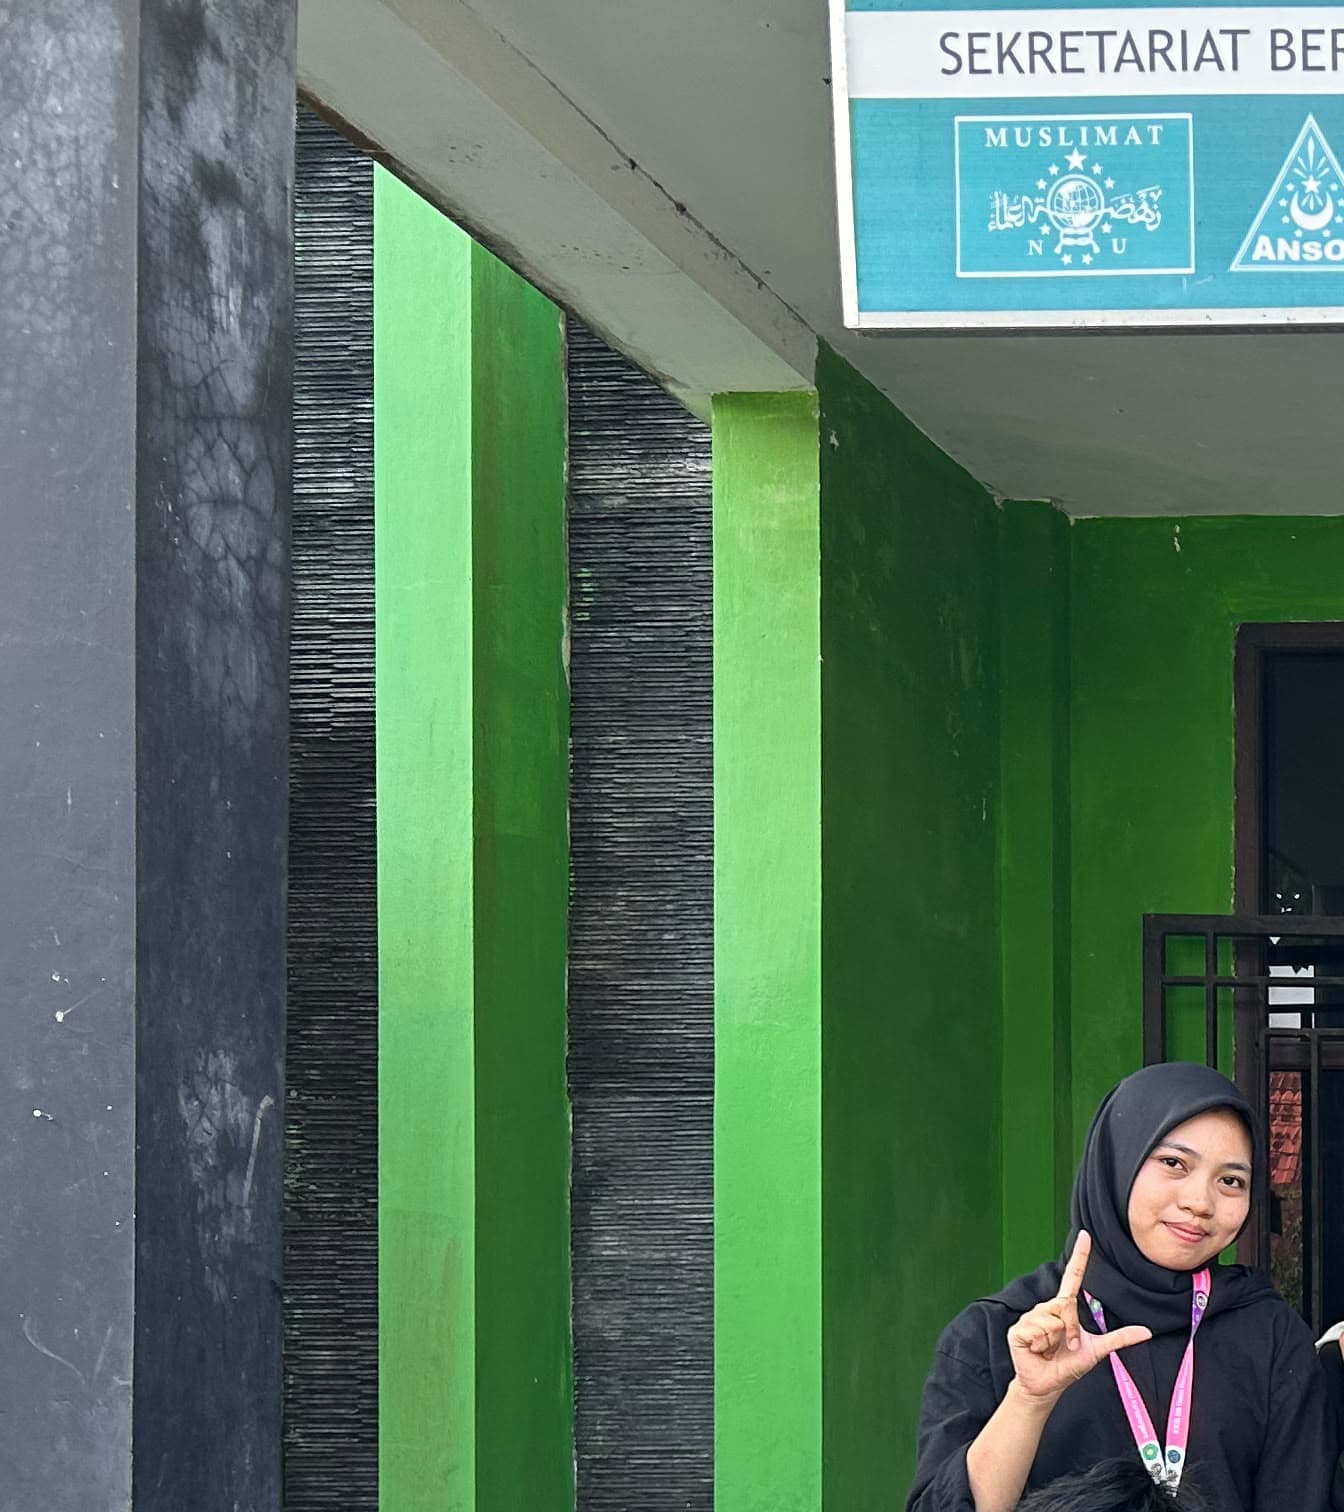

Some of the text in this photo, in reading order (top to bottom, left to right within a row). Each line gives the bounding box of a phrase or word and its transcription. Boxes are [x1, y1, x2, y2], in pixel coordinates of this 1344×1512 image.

[939, 29, 1252, 76] SEKRETARIAT
[985, 125, 1164, 147] MUSLIMAT
[1027, 238, 1127, 256] N U
